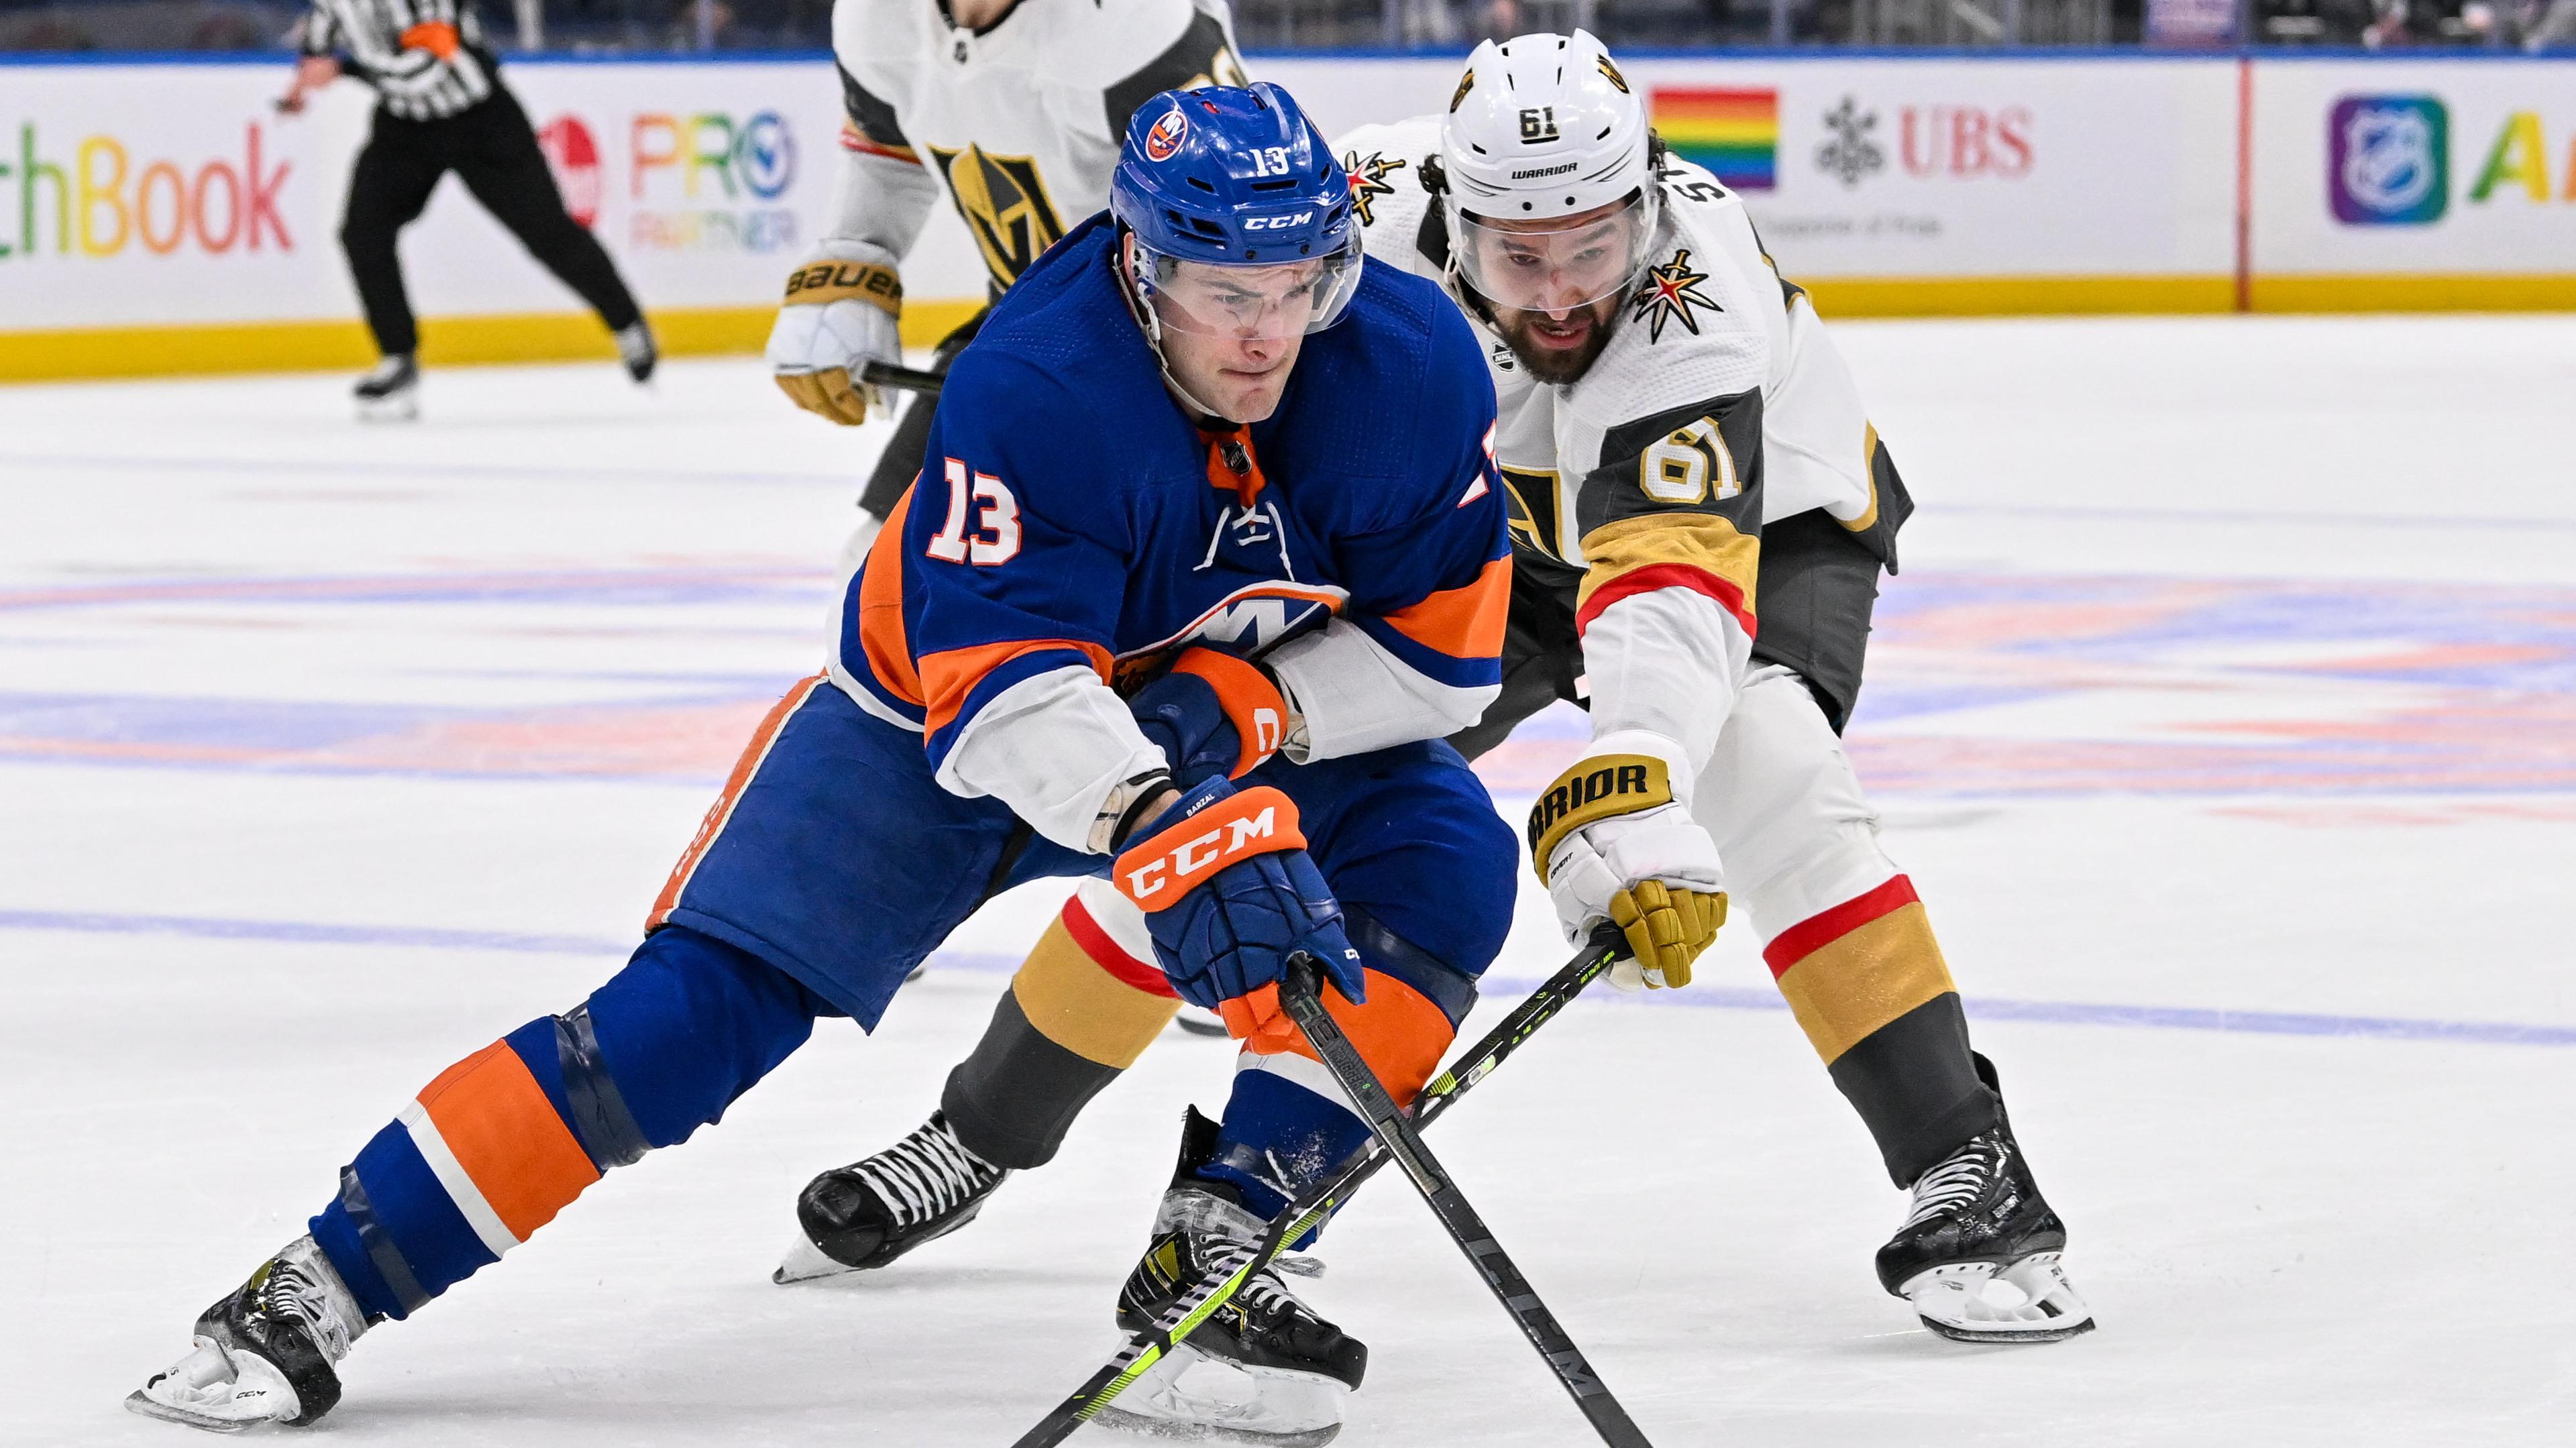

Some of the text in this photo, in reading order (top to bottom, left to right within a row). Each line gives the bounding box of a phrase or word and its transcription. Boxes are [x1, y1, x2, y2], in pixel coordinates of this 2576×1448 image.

[1519, 106, 1558, 138] 61
[631, 113, 798, 199] PRO
[1900, 106, 2034, 177] UBS
[1249, 146, 1289, 177] 13
[1511, 162, 1578, 179] WARRIOR
[1244, 211, 1313, 229] CCM
[1640, 416, 1742, 504] 61
[926, 457, 1022, 566] 13
[1186, 793, 1216, 817] BARZAL
[1127, 806, 1275, 899] CCM
[1550, 852, 1574, 879] COVERT
[1361, 1080, 1372, 1091] 6
